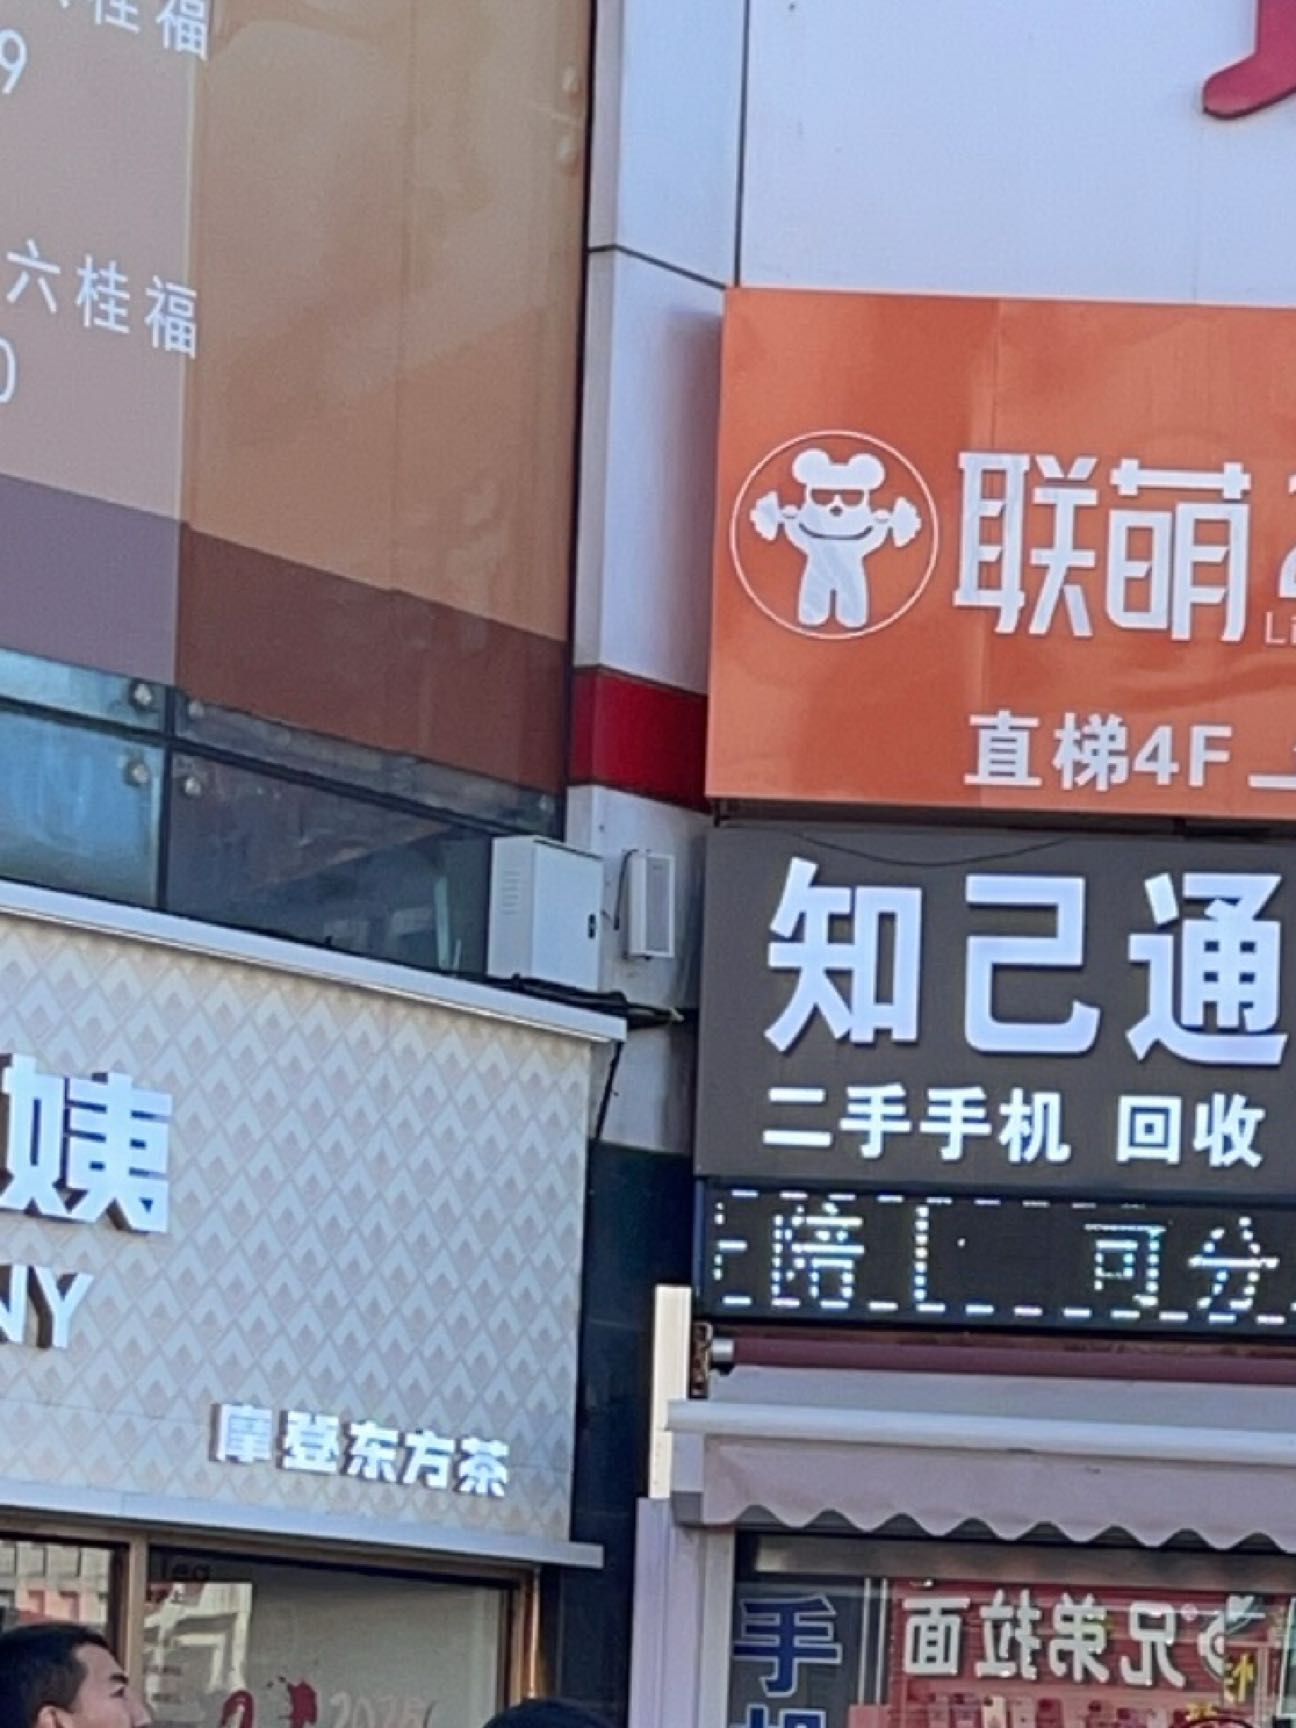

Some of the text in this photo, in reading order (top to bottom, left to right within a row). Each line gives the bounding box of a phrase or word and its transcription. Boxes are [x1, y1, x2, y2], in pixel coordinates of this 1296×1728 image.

[7, 239, 197, 359] 六桂福
[964, 709, 1233, 791] 直梯4F
[762, 1083, 1071, 1164] 二手手机
[1116, 1093, 1266, 1168] 回收
[212, 1403, 511, 1497] 摩登东方茶
